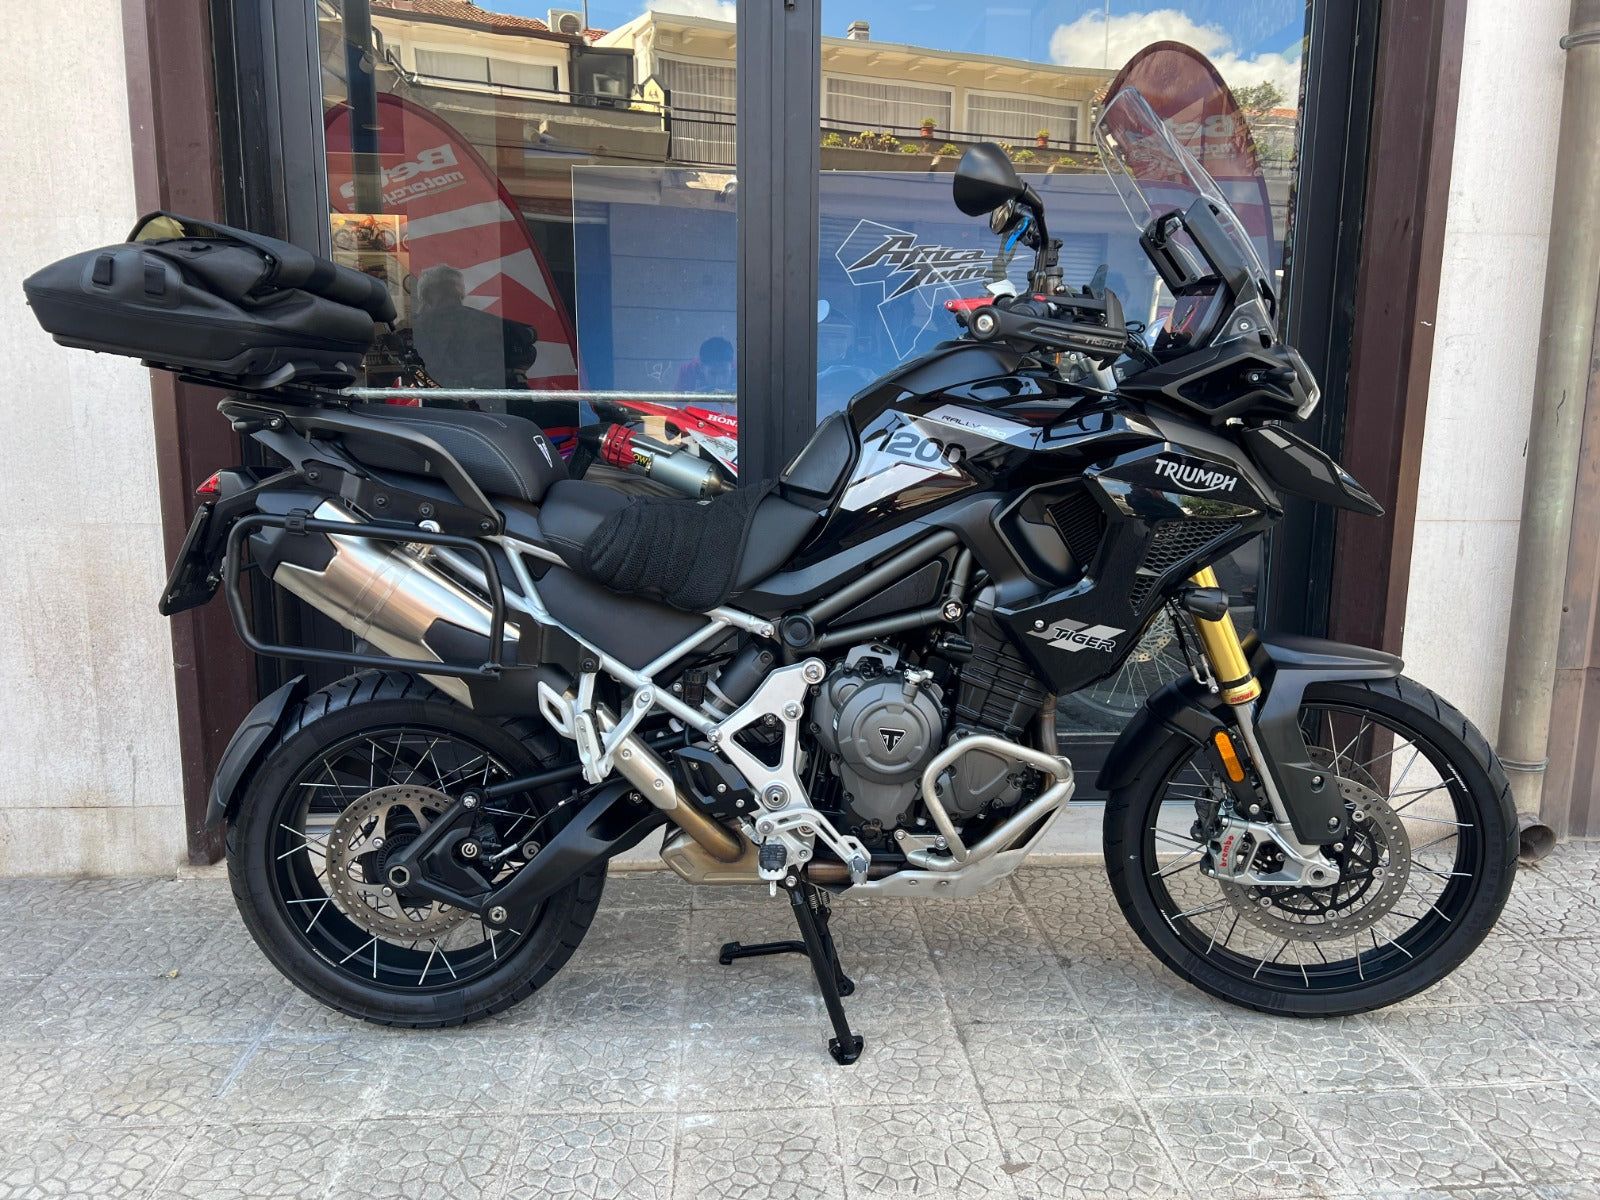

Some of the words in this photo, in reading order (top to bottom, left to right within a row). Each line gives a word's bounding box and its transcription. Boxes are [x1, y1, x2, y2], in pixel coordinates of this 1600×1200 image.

[847, 234, 988, 277] Africa
[706, 413, 738, 428] HON
[1154, 458, 1238, 492] TRIUMPH
[1053, 626, 1117, 653] TIGER
[1219, 835, 1235, 868] brembo
